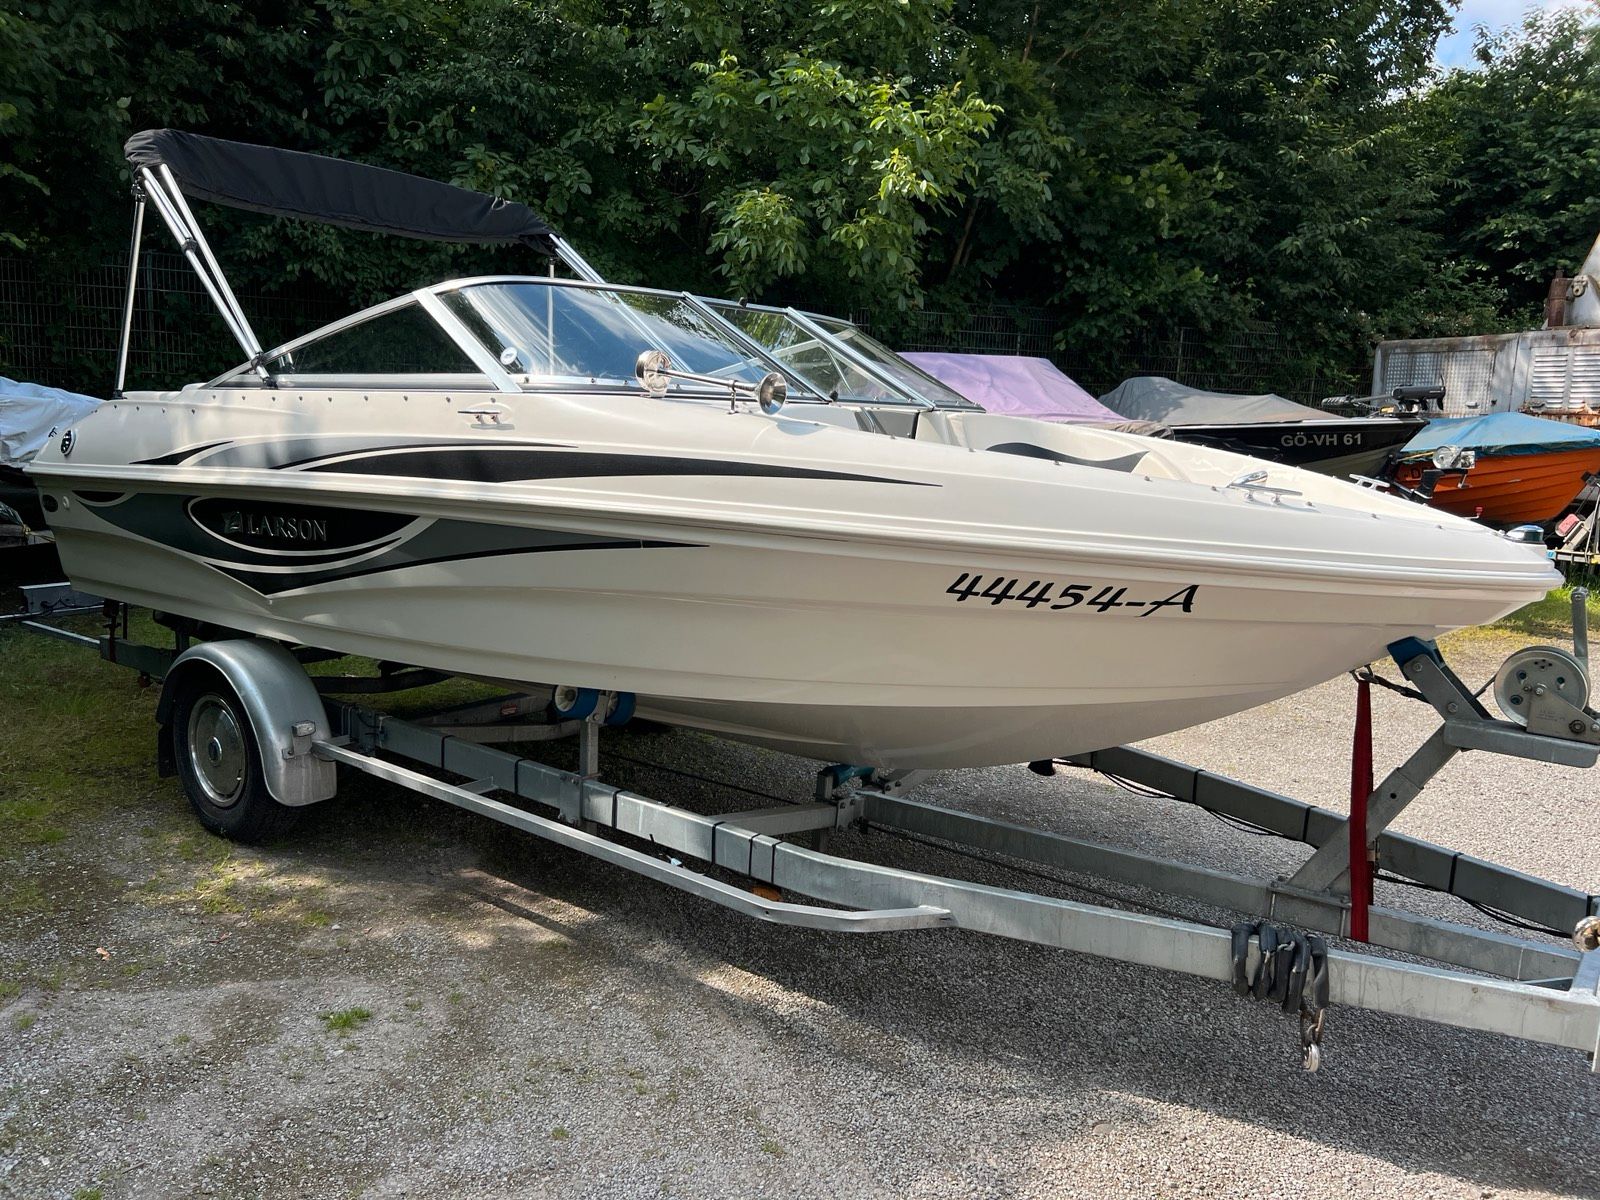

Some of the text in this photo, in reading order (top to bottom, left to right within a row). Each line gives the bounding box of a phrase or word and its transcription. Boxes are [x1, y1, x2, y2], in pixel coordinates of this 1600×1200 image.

[1281, 432, 1362, 447] GÖ-VH 61
[246, 513, 327, 541] LARSON
[946, 573, 1200, 617] 44454-A
